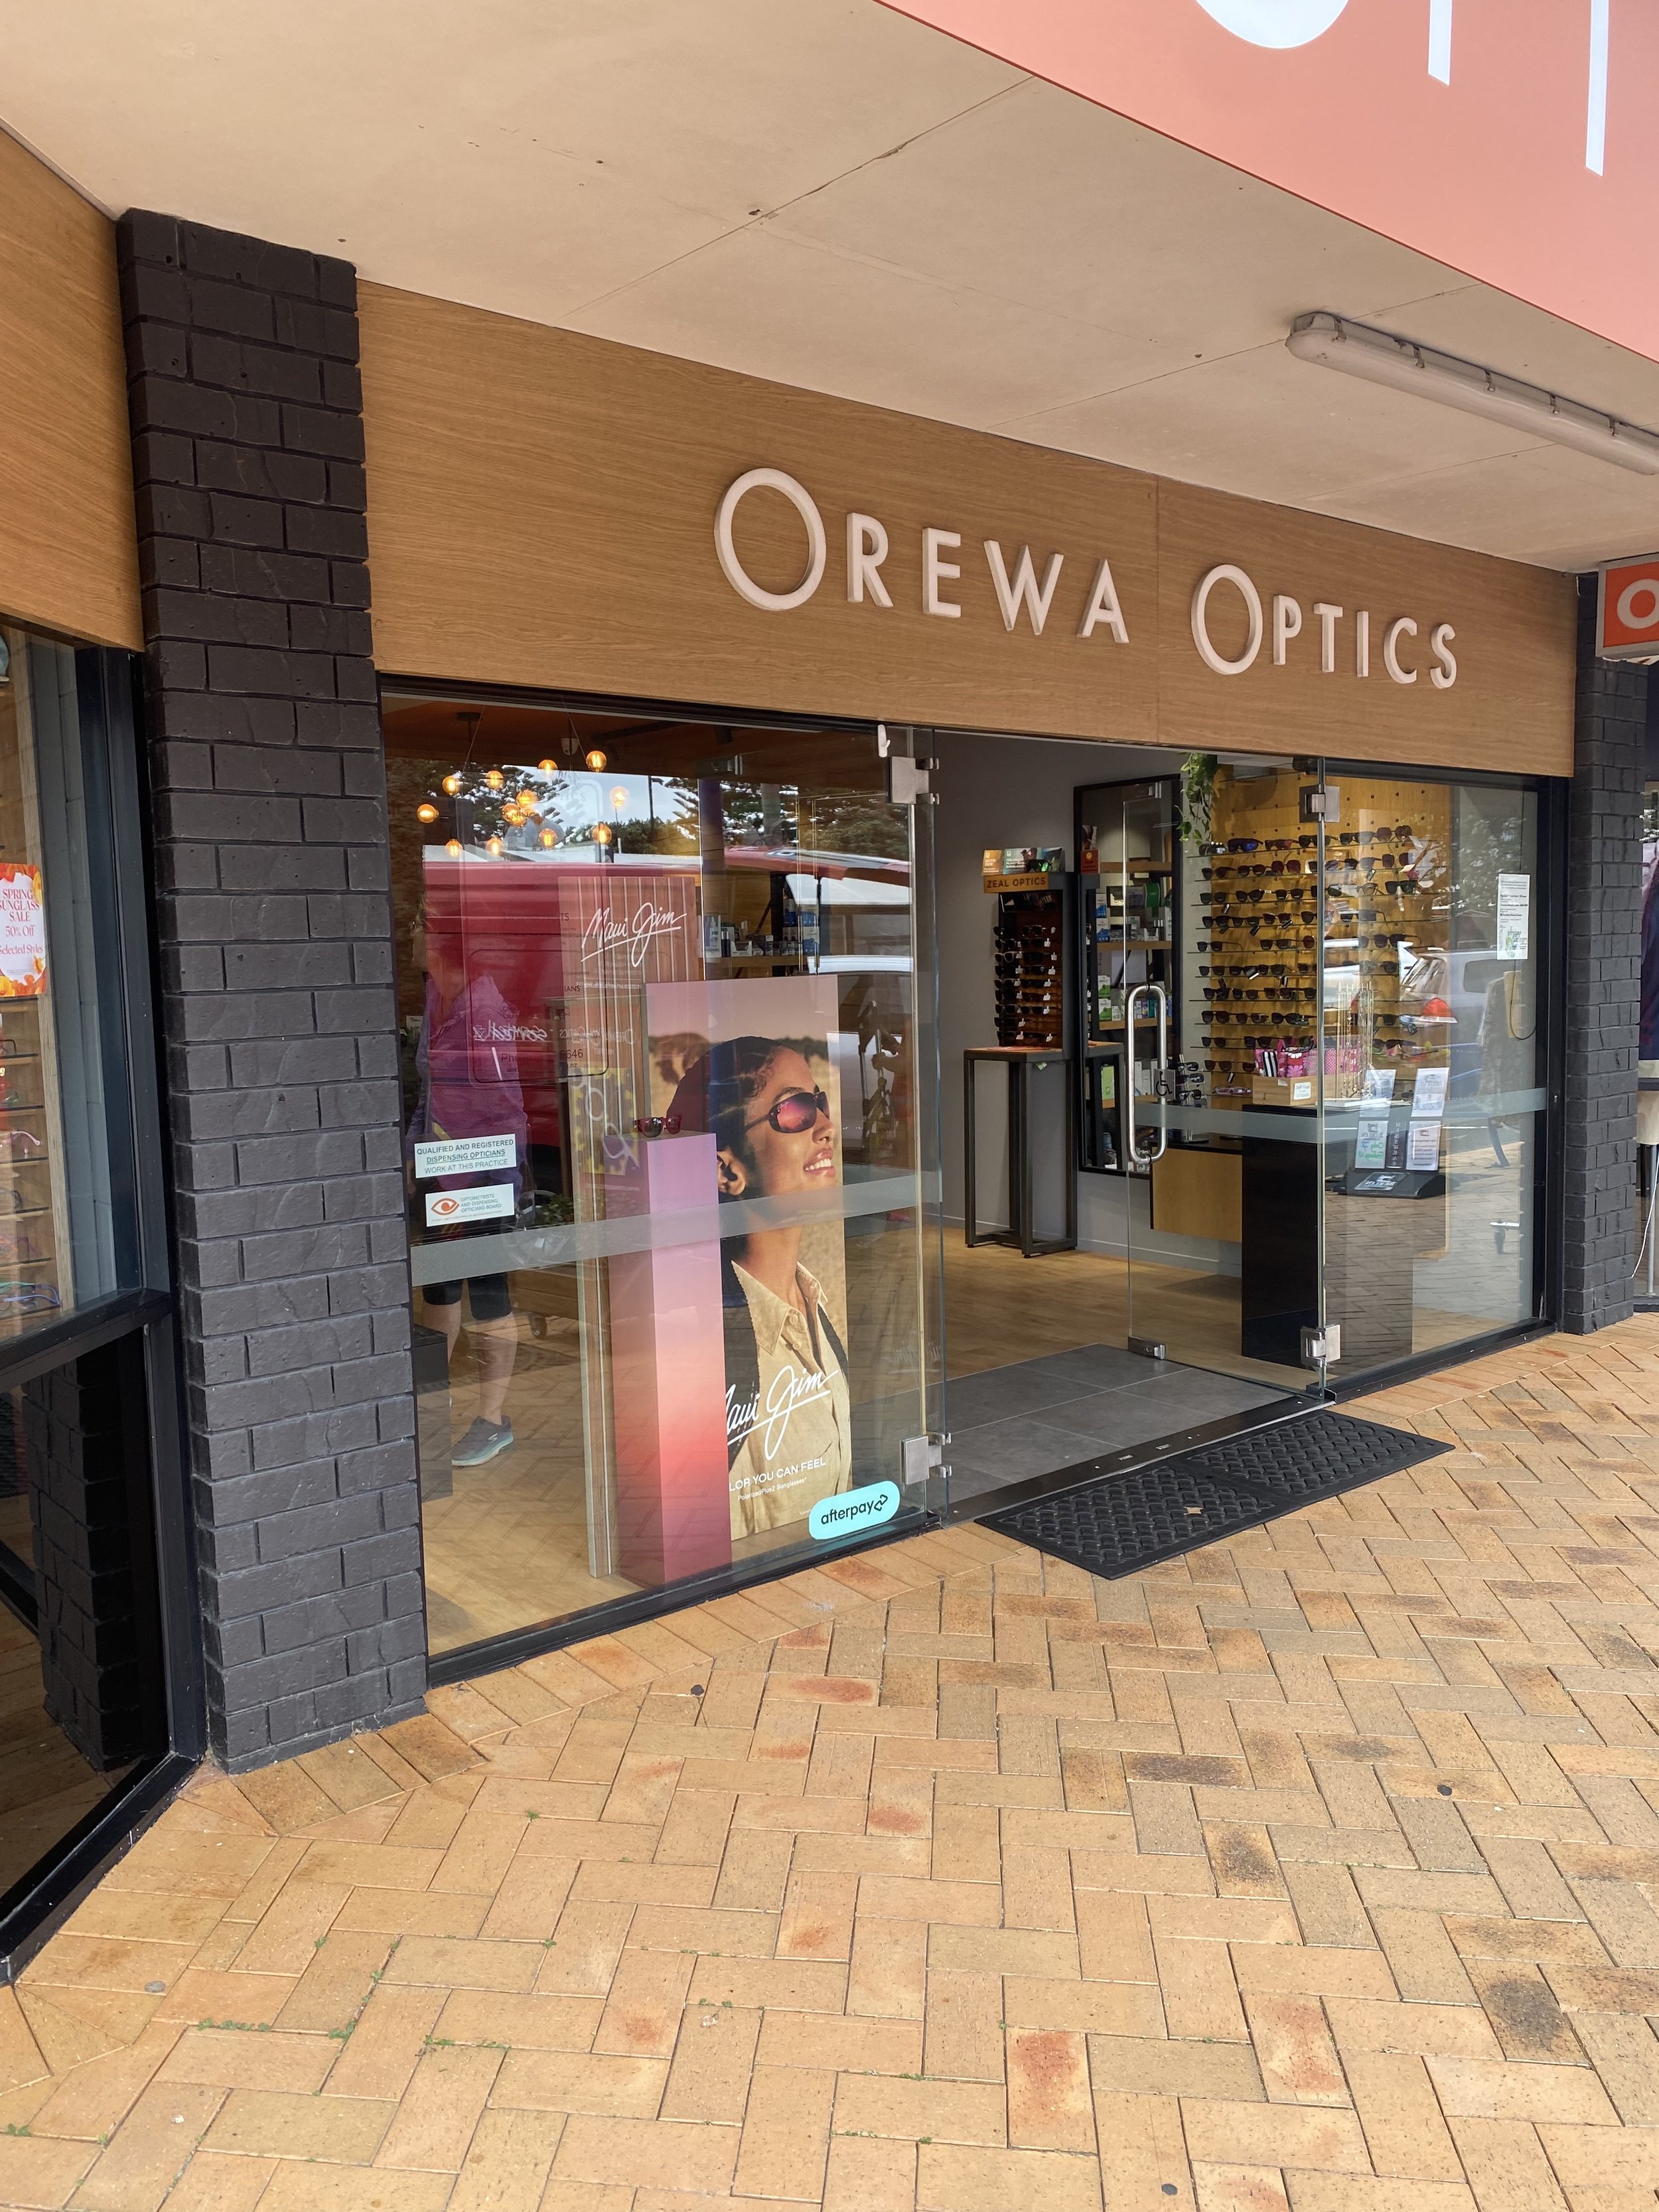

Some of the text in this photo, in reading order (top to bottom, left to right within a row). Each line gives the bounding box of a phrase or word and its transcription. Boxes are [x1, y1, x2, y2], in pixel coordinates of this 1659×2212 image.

[714, 467, 1457, 689] OREWA OPTICS
[1013, 877, 1046, 887] OPTICS
[3, 889, 33, 899] SPRING
[9, 911, 31, 922] SALE
[23, 924, 35, 936] Off
[581, 902, 687, 968] Maui Jim
[27, 944, 43, 954] Styles
[417, 1145, 453, 1155] QUALIFIED
[472, 1140, 514, 1149] REGISTERED
[427, 1149, 506, 1163] DISPENSING OPTICIANS
[425, 1165, 446, 1174] WORK
[475, 1159, 508, 1168] PRACTICE
[764, 1365, 839, 1461] Jim
[753, 1471, 774, 1485] YOU
[776, 1464, 798, 1479] CAN
[801, 1457, 827, 1472] FEEL
[821, 1501, 874, 1524] afterpay
